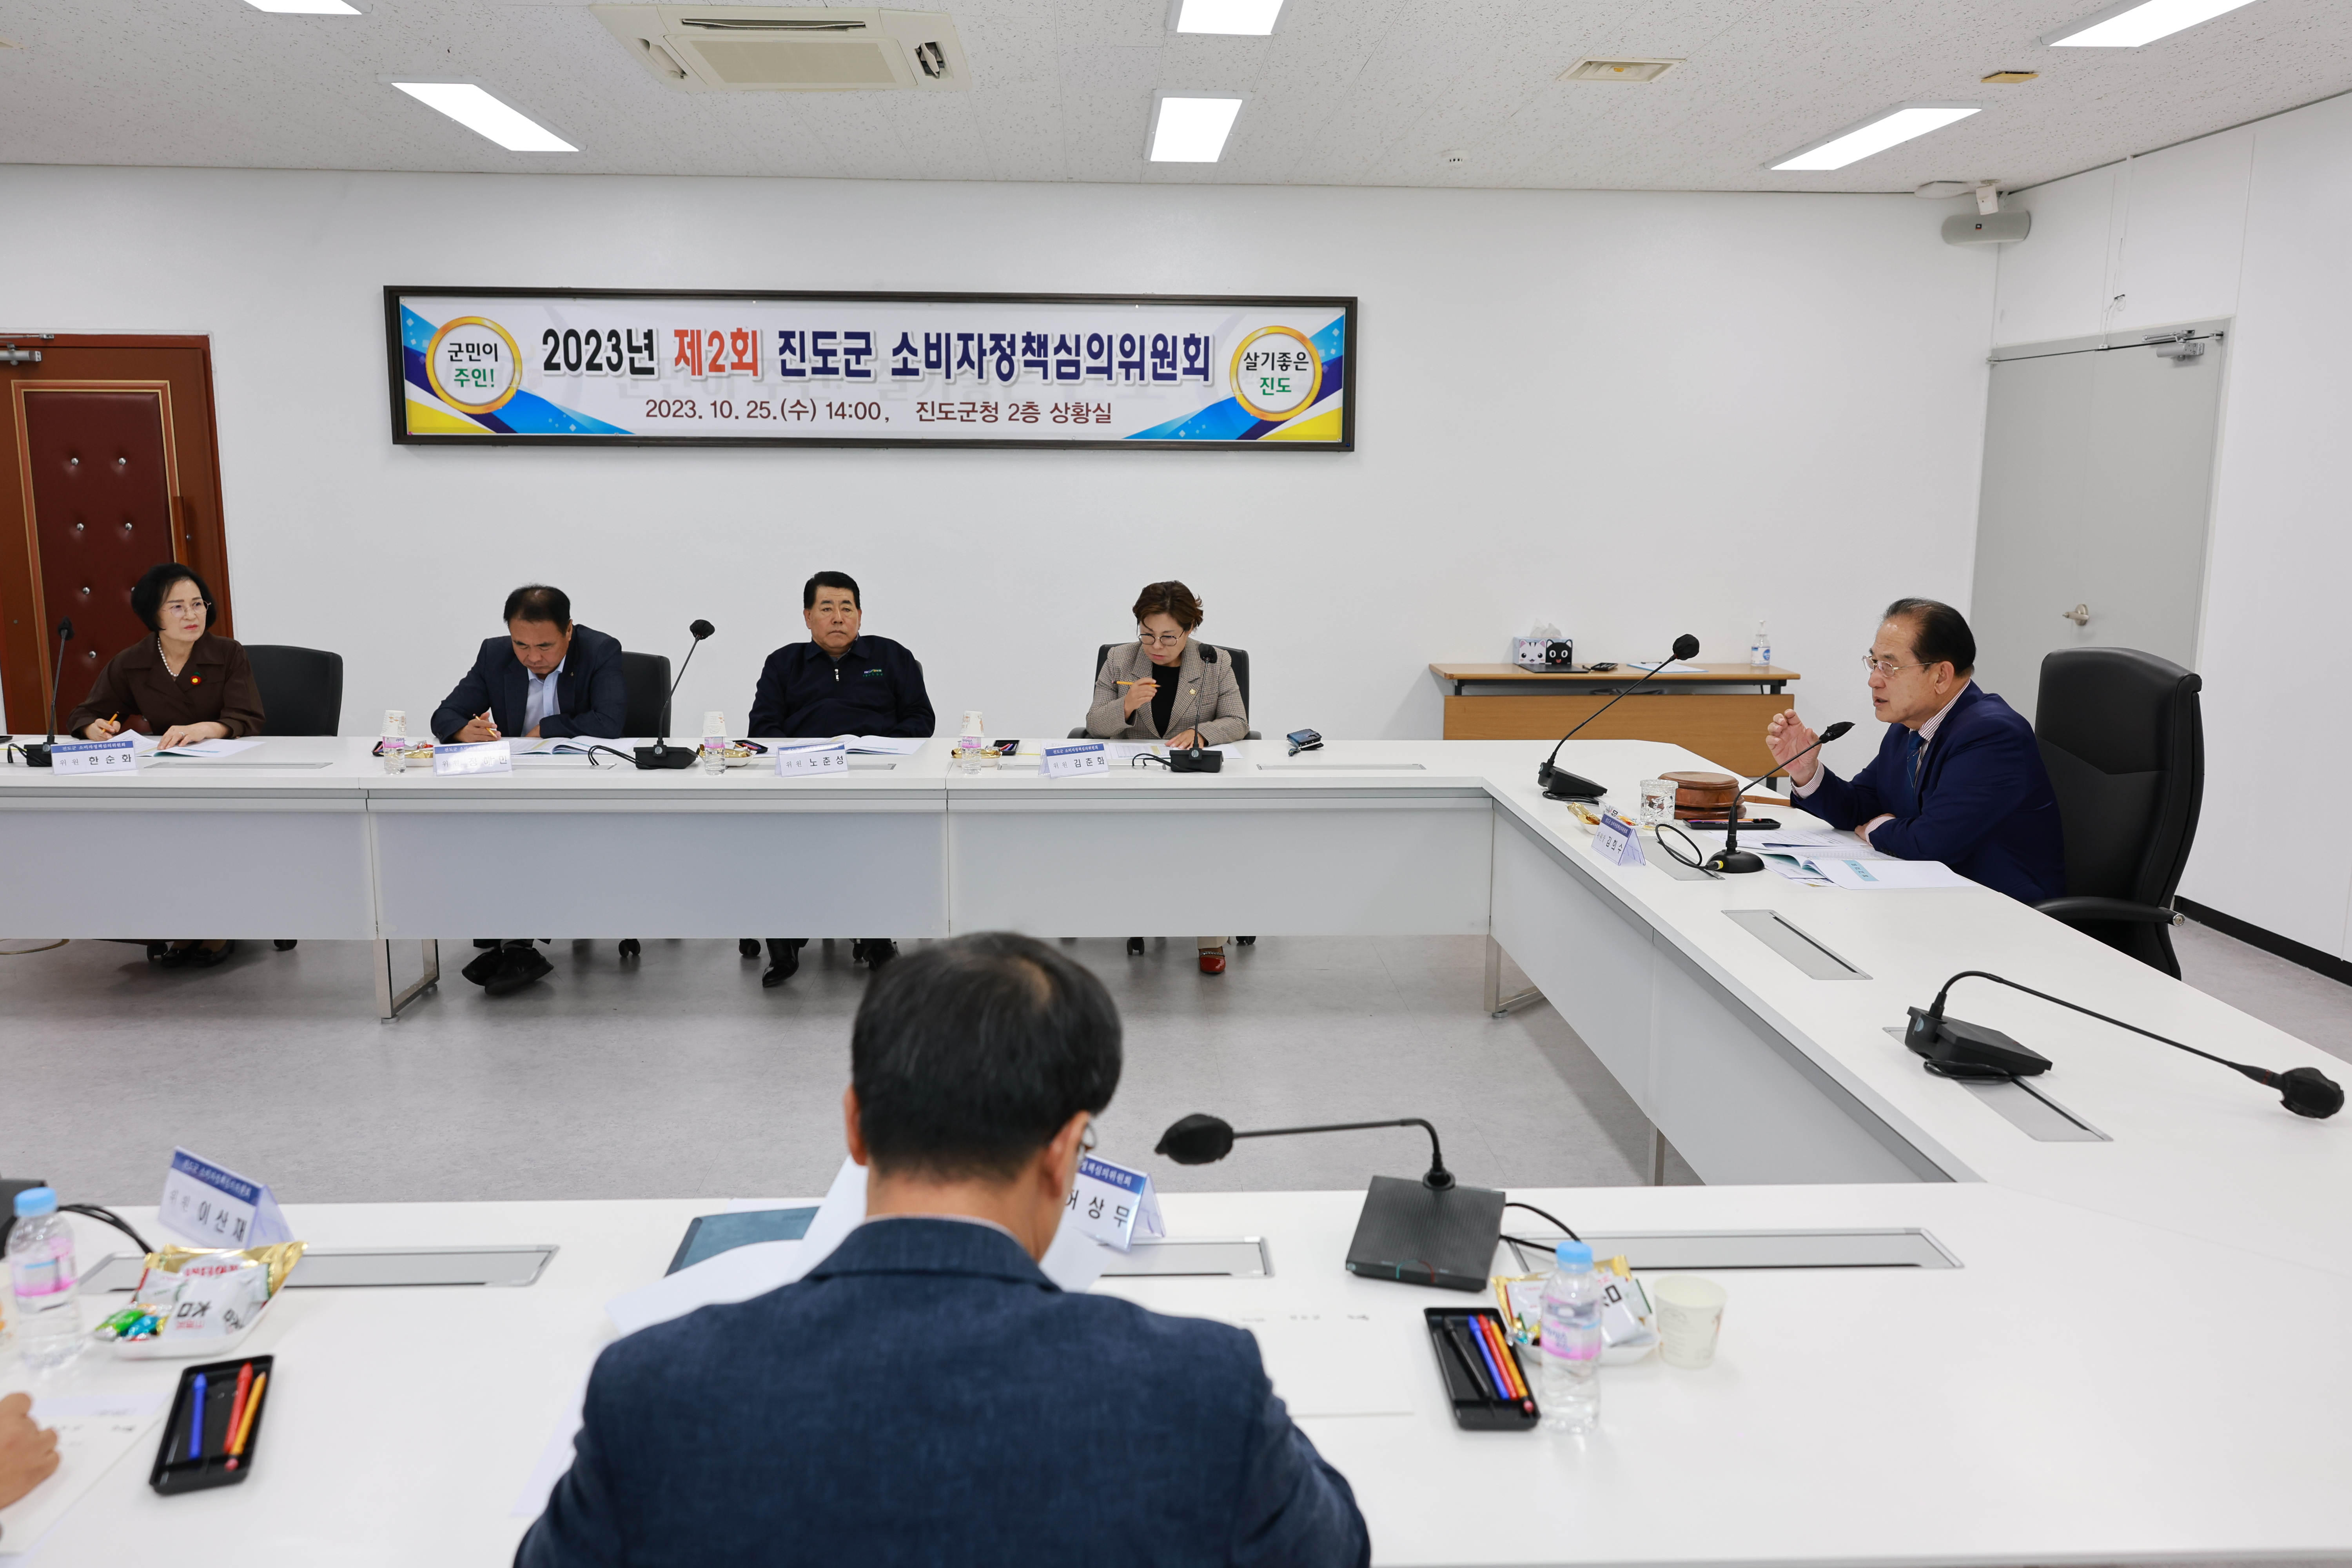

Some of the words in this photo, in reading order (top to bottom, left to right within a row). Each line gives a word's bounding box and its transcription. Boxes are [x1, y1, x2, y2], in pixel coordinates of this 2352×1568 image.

[448, 343, 498, 362] 군민이
[543, 328, 655, 375] 2023년
[674, 328, 758, 376] 제2회
[779, 330, 872, 378] 진도군
[891, 331, 1209, 382] 소비자정책심의위원회
[1243, 351, 1309, 372] 살기좋은
[454, 368, 494, 387] 주인!
[1260, 377, 1292, 396] 진도
[646, 399, 702, 419] 2023.
[710, 400, 739, 419] 10.
[747, 398, 816, 422] 25.(수)
[916, 401, 998, 423] 진도군청
[1008, 401, 1041, 423] 2층
[1050, 402, 1111, 424] 상황실
